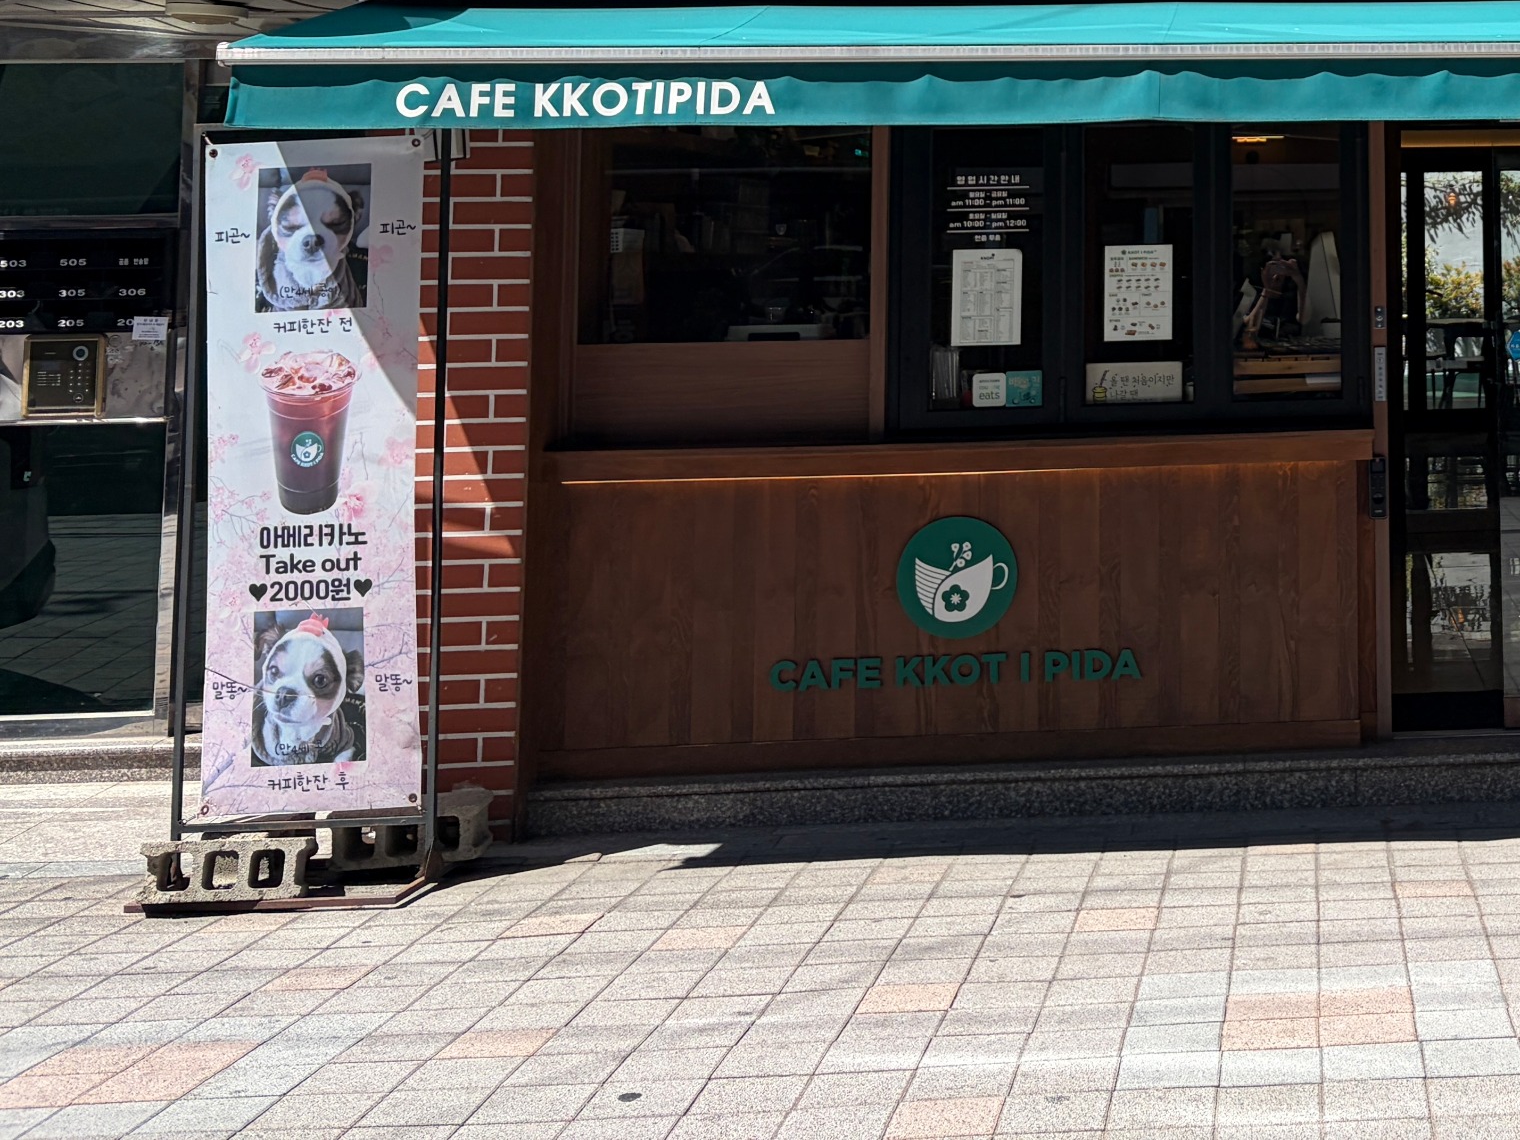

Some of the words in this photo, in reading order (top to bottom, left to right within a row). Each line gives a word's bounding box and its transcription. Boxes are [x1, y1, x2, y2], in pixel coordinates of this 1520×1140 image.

[396, 83, 515, 118] CAFE
[534, 81, 776, 117] KKOTIPIDA
[0, 260, 27, 268] 503
[59, 259, 87, 267] 505
[0, 290, 25, 298] 303
[58, 289, 86, 297] 305
[118, 288, 147, 296] 306
[0, 320, 24, 328] 203
[57, 319, 85, 327] 205
[273, 317, 332, 335] 커피한잔
[339, 317, 353, 333] 전
[979, 391, 1000, 400] eats
[259, 523, 368, 549] 아메리카노
[259, 552, 316, 575] Take
[321, 551, 362, 573] out
[269, 578, 352, 603] 2000원
[769, 656, 883, 692] CAFE
[896, 653, 1007, 689] KKOT
[1020, 651, 1030, 684] I
[1044, 648, 1143, 682] PIDA
[267, 772, 328, 793] 커피한잔
[335, 771, 350, 791] 후
